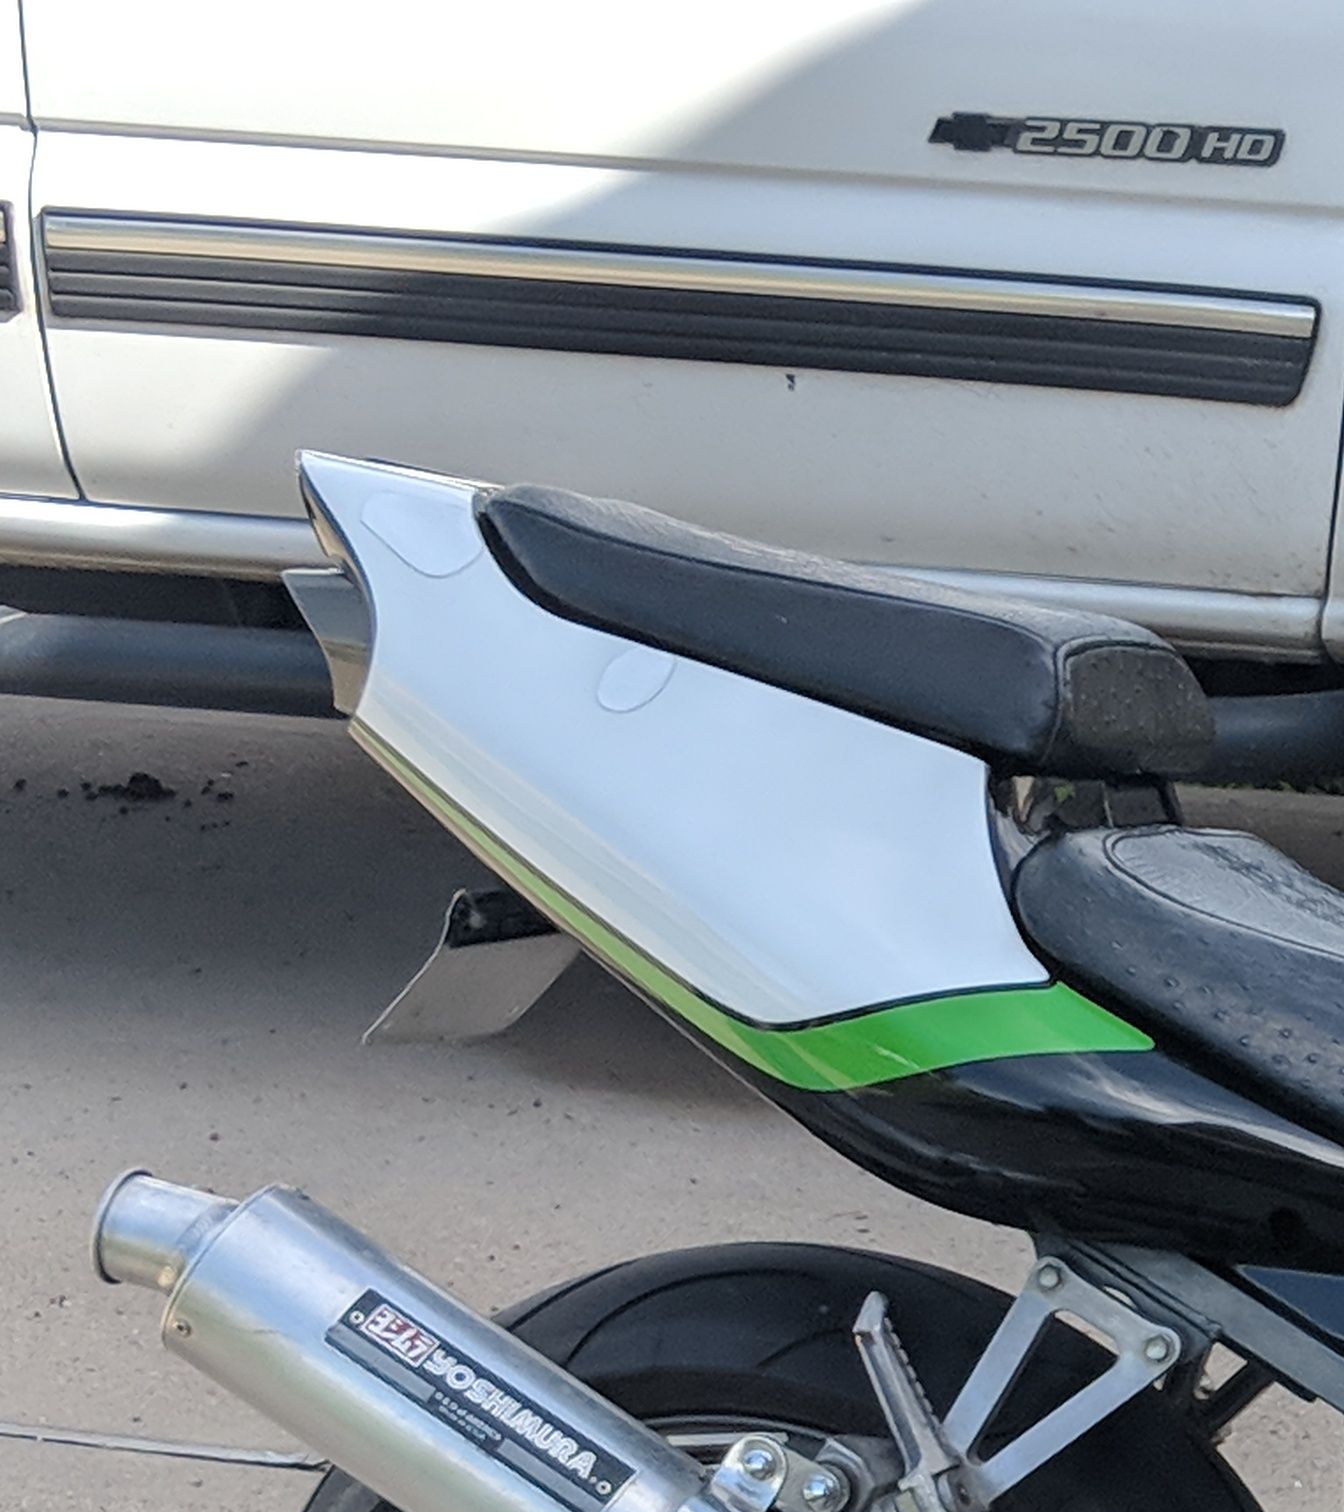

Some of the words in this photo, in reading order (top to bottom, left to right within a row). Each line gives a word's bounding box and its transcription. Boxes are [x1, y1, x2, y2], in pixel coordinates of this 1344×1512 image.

[1016, 118, 1192, 160] 2500
[1202, 131, 1276, 161] HD
[422, 1347, 597, 1480] YOSHIMURA
